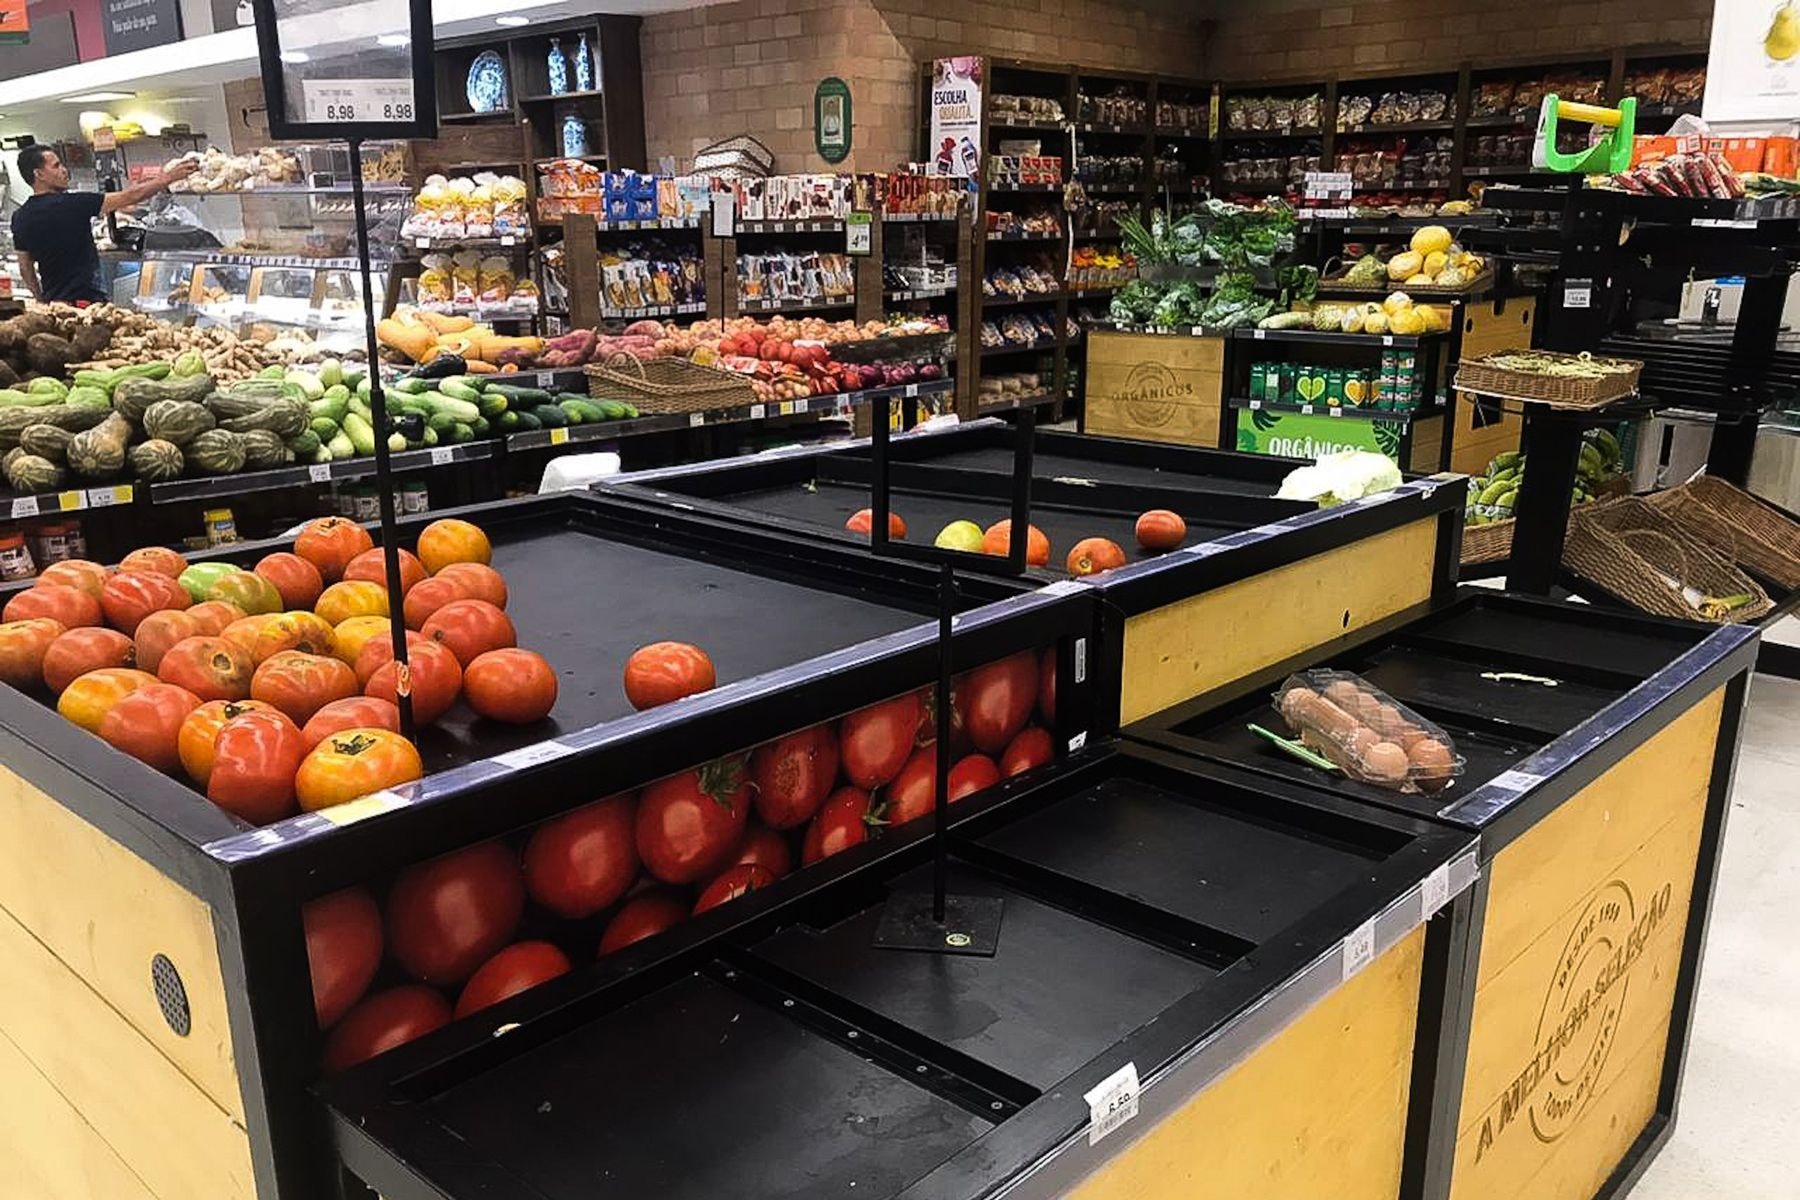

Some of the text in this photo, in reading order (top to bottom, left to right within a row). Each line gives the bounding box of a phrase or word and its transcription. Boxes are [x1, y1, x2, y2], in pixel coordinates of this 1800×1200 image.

[934, 90, 967, 105] ESCOLHA
[1111, 383, 1193, 402] ORGÂNICOS
[1269, 436, 1366, 459] ORGÂNIC
[1558, 902, 1621, 989] DESDE 1959
[1474, 882, 1672, 1166] A MELHOR SELEÇÃO
[1543, 1091, 1573, 1119] TODOS
